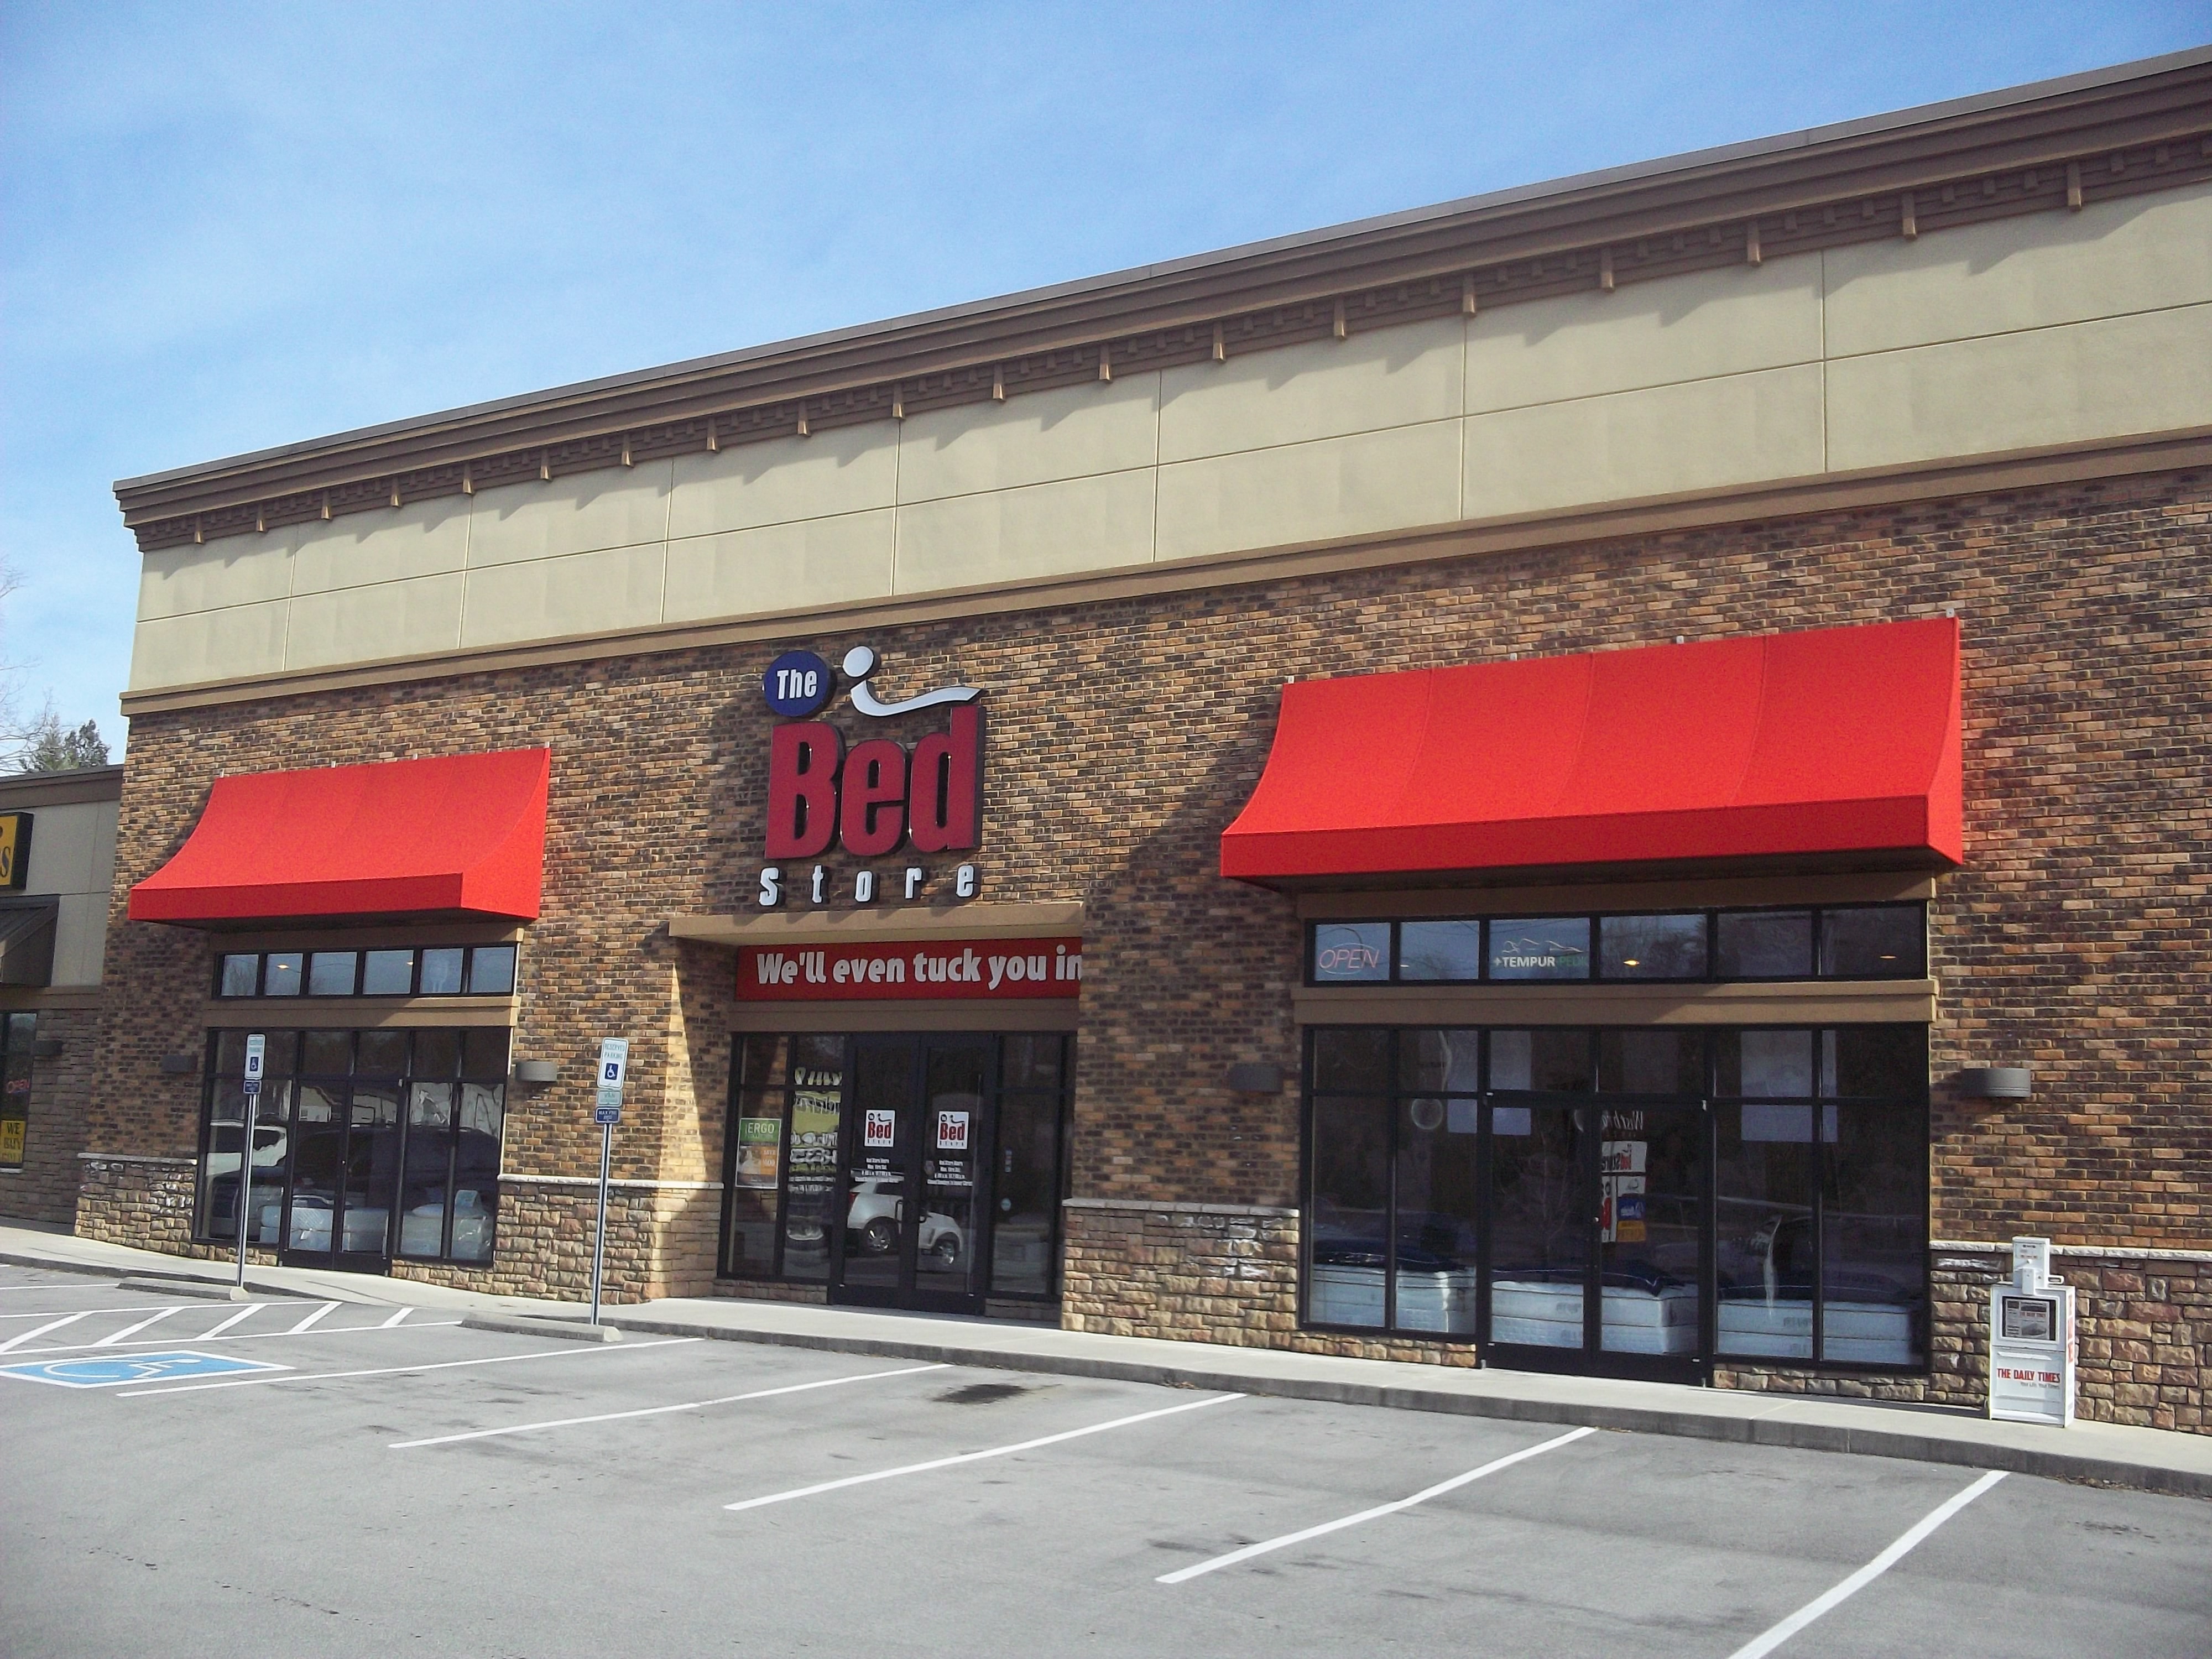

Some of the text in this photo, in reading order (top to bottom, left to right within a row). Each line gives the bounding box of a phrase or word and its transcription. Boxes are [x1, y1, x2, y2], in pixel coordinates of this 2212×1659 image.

[776, 670, 817, 700] The
[764, 705, 980, 859] Bed
[758, 864, 976, 907] store
[757, 944, 1082, 990] We'll even tuck you in
[1319, 949, 1379, 968] OPEN
[1503, 956, 1556, 967] TEMPUR
[748, 1123, 775, 1133] ERGO
[868, 1121, 892, 1139] Bed
[940, 1123, 965, 1140] Bed
[1997, 1368, 2060, 1383] THE DAILY TIMES
